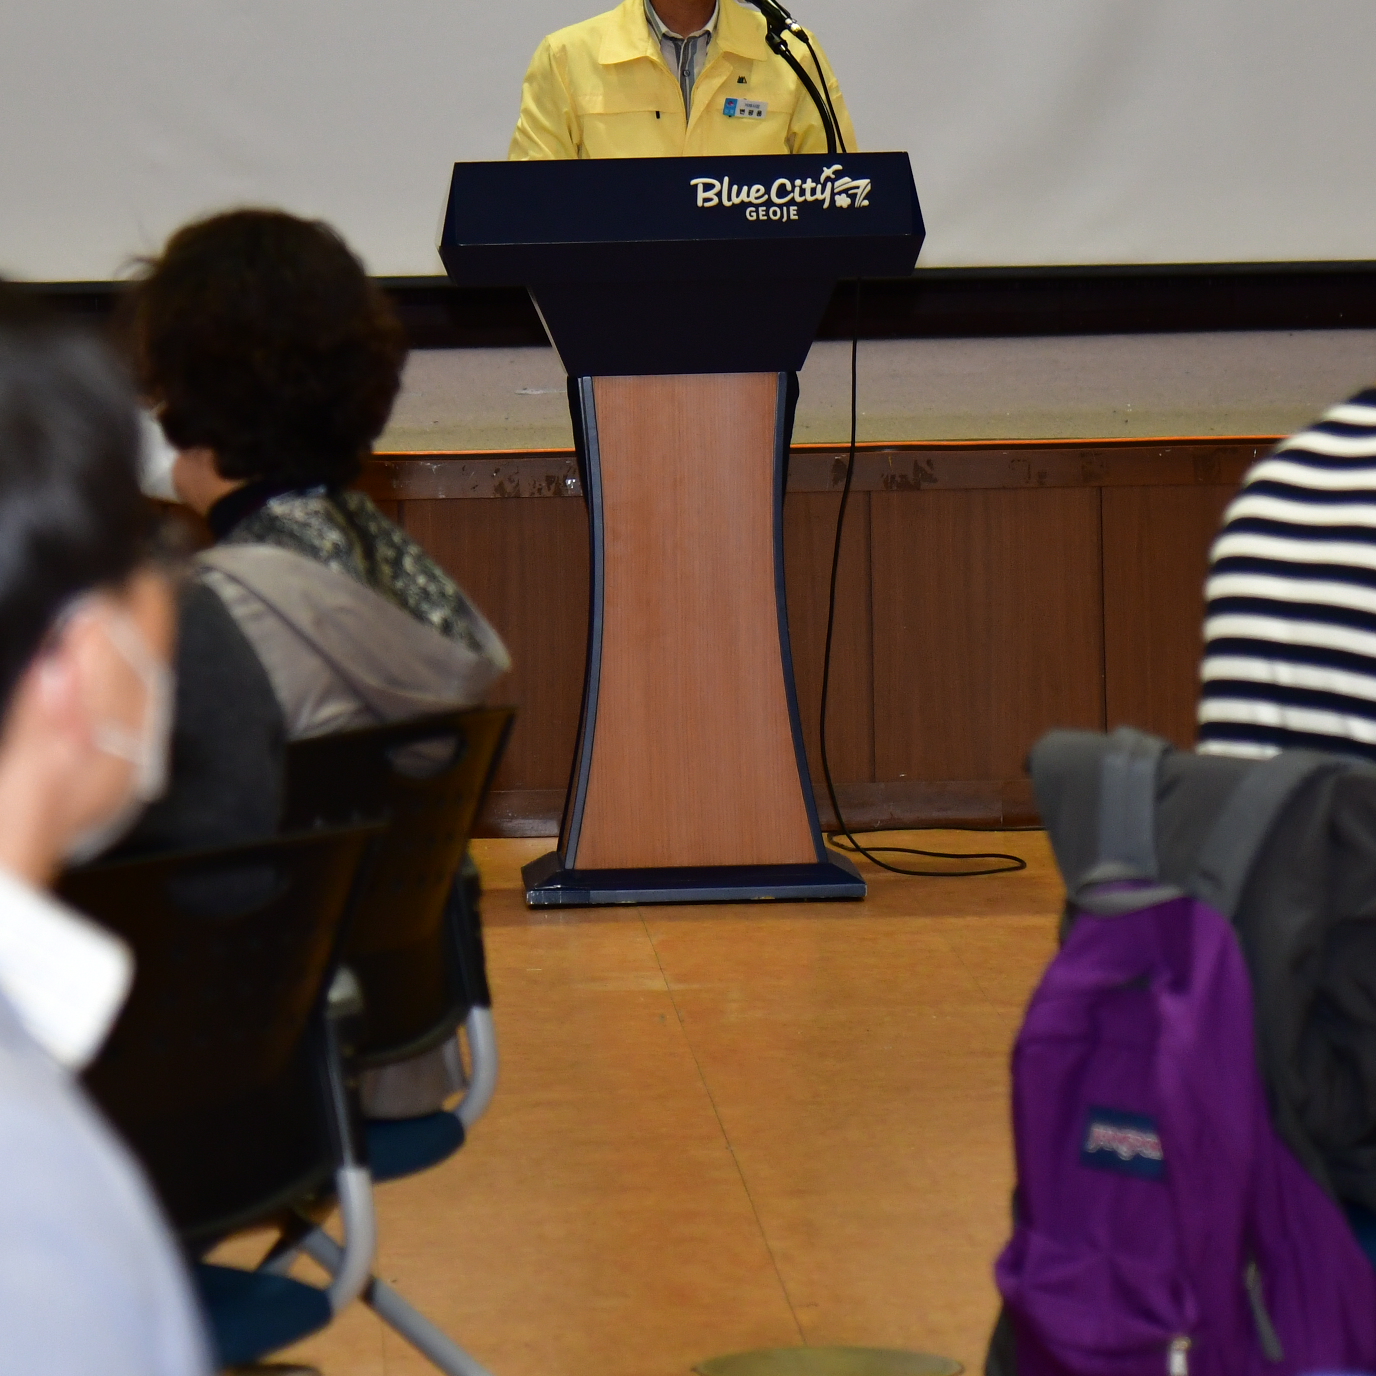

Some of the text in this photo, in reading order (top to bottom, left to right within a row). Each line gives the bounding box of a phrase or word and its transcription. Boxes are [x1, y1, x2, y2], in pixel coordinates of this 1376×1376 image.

[690, 176, 833, 209] Blue City
[745, 206, 799, 222] GEOJE
